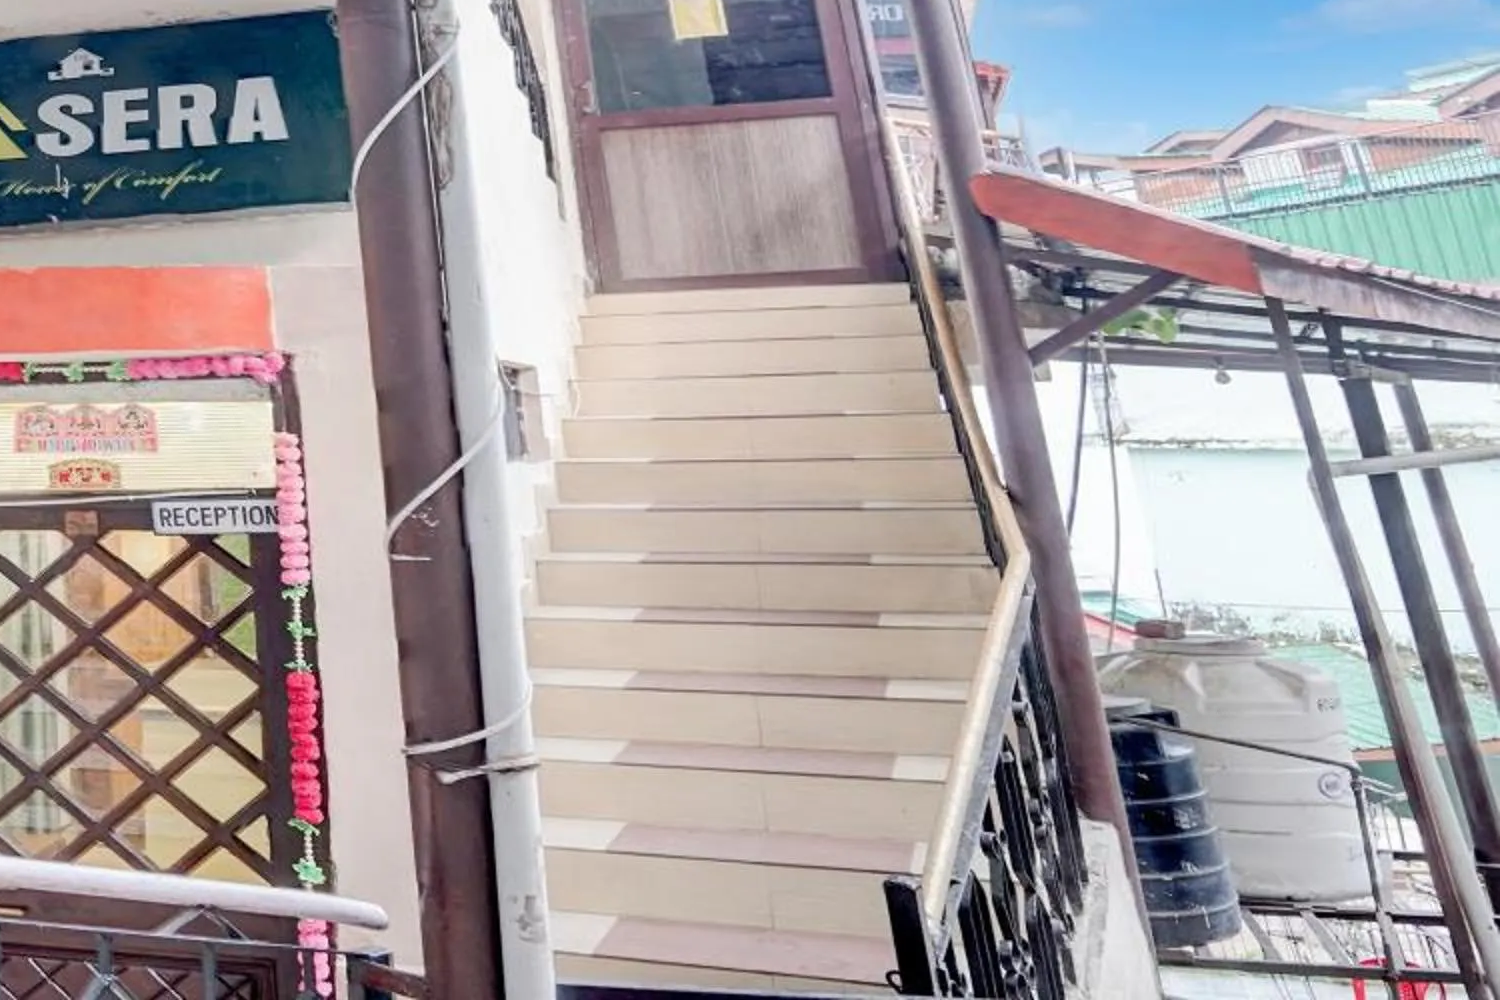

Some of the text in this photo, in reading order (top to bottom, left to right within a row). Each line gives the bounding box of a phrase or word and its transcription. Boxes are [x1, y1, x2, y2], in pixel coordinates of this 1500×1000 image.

[82, 167, 121, 205] of
[114, 158, 224, 201] Comfort
[159, 505, 281, 528] RECEPTION
